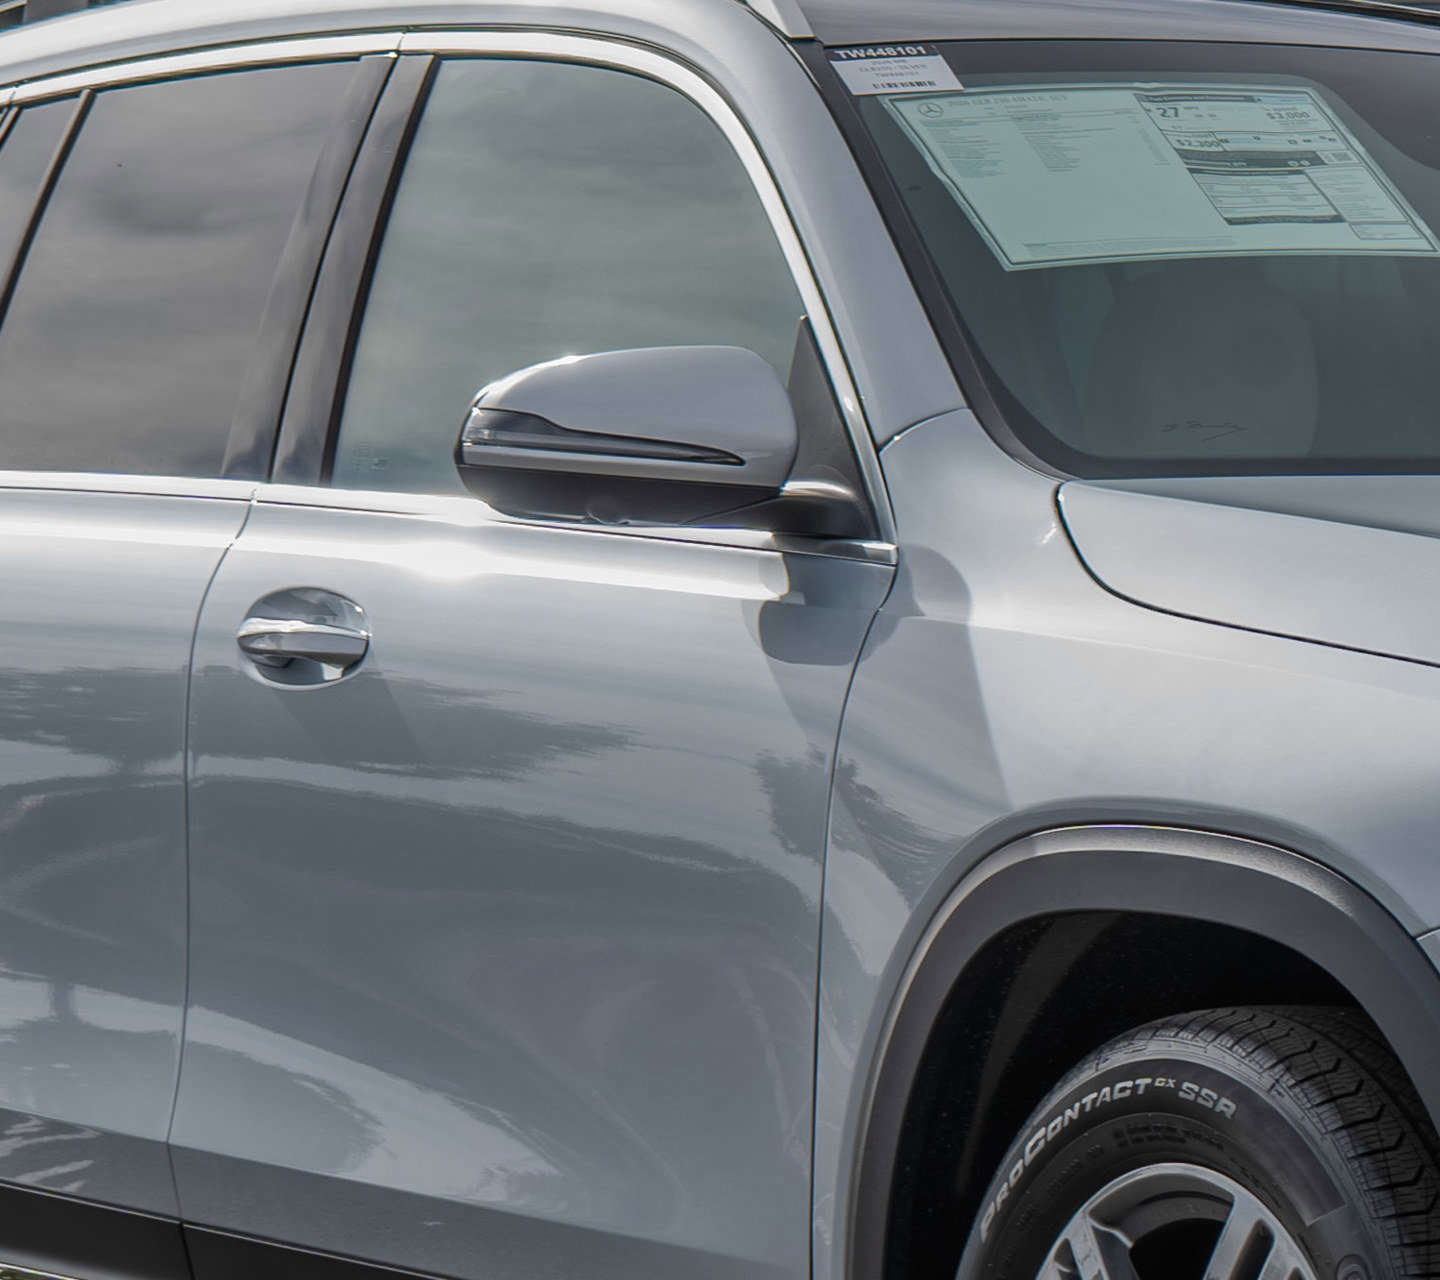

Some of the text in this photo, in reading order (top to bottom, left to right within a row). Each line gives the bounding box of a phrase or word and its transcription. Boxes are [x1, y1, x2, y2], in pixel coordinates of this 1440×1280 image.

[833, 45, 929, 59] TW448101
[979, 1077, 1153, 1244] PROCONTACT
[1153, 1076, 1177, 1089] GX
[1177, 1081, 1238, 1120] SSR
